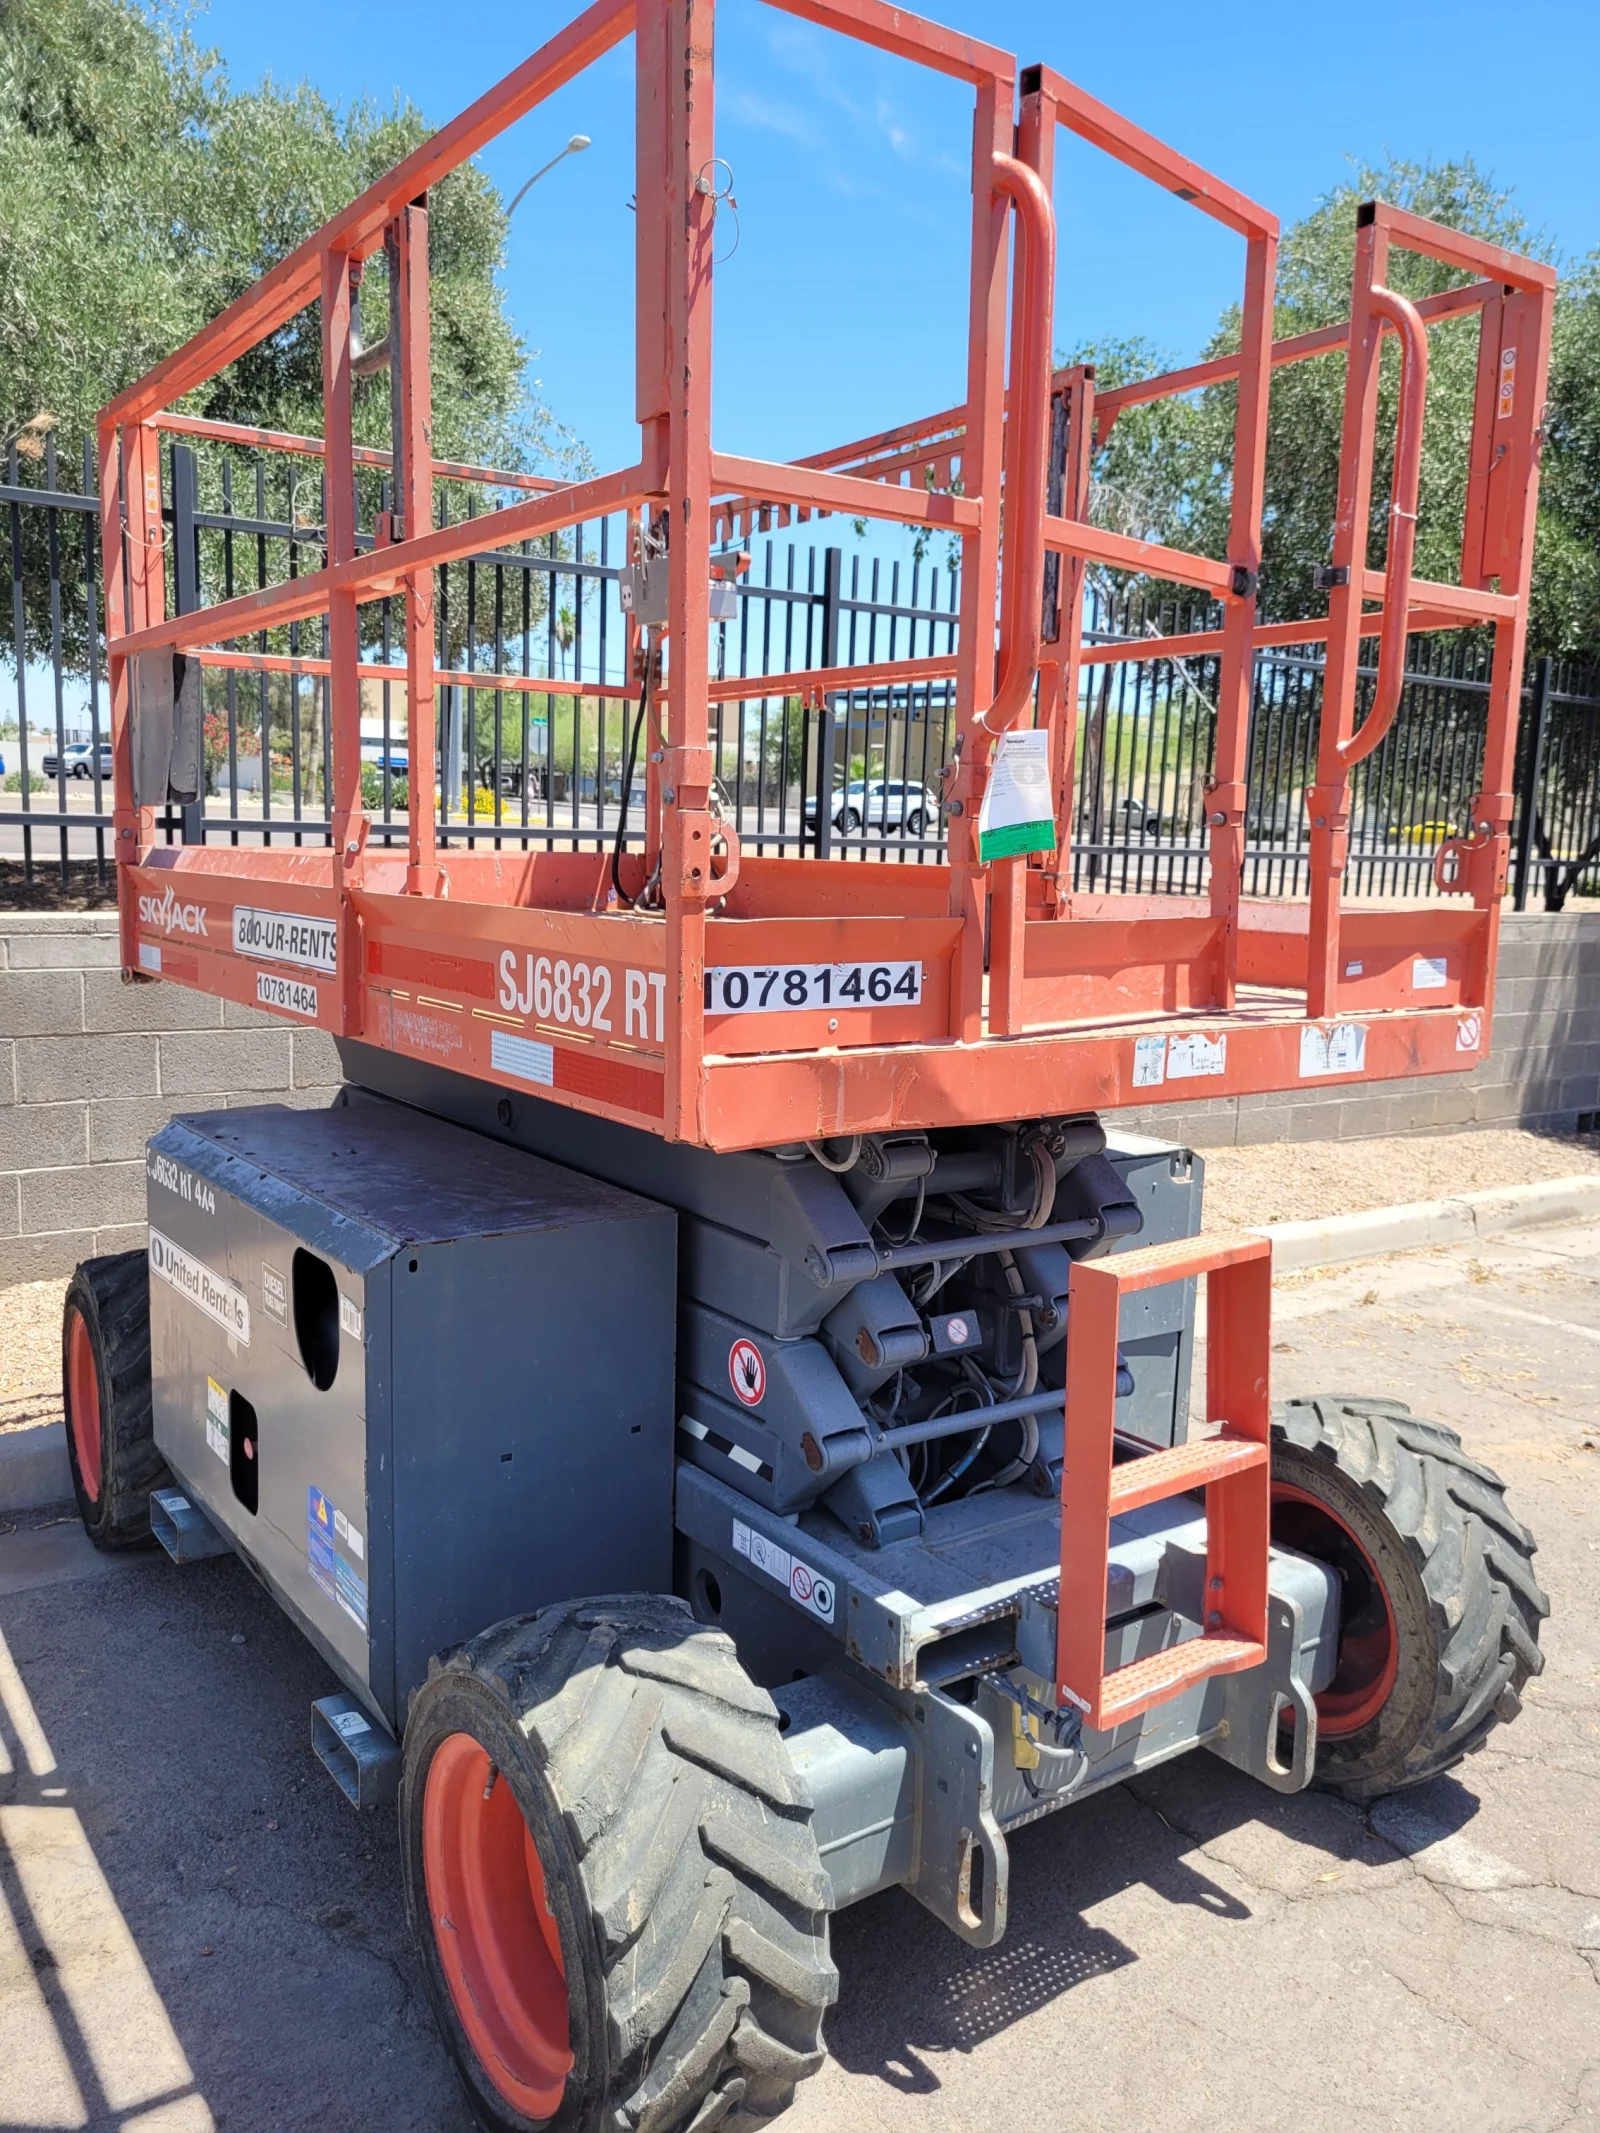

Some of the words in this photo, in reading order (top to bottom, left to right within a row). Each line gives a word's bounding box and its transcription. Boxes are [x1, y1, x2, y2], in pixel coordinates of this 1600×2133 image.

[139, 885, 208, 936] SKYJACK
[239, 918, 337, 962] 800-UR-RENTS
[257, 976, 317, 1013] 10781464
[499, 949, 613, 1031] SJ6832
[625, 968, 667, 1042] RT
[703, 966, 919, 1010] 10781464
[166, 1247, 199, 1295] United
